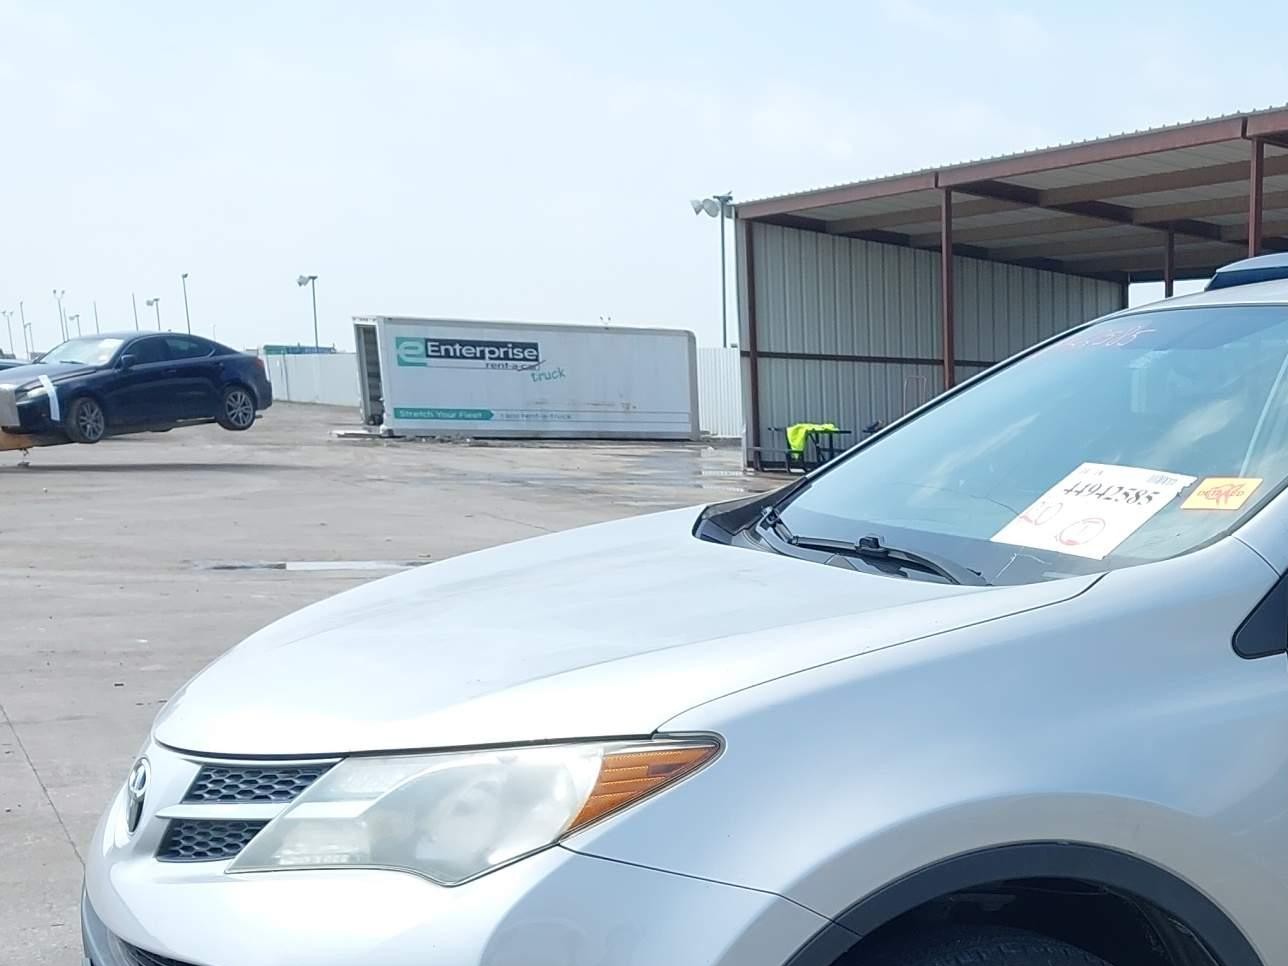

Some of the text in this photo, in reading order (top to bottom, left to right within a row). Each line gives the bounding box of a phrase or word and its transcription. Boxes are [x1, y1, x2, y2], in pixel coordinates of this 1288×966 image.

[427, 341, 537, 361] Enterprise
[531, 368, 566, 382] truck
[1063, 480, 1161, 506] 44942585
